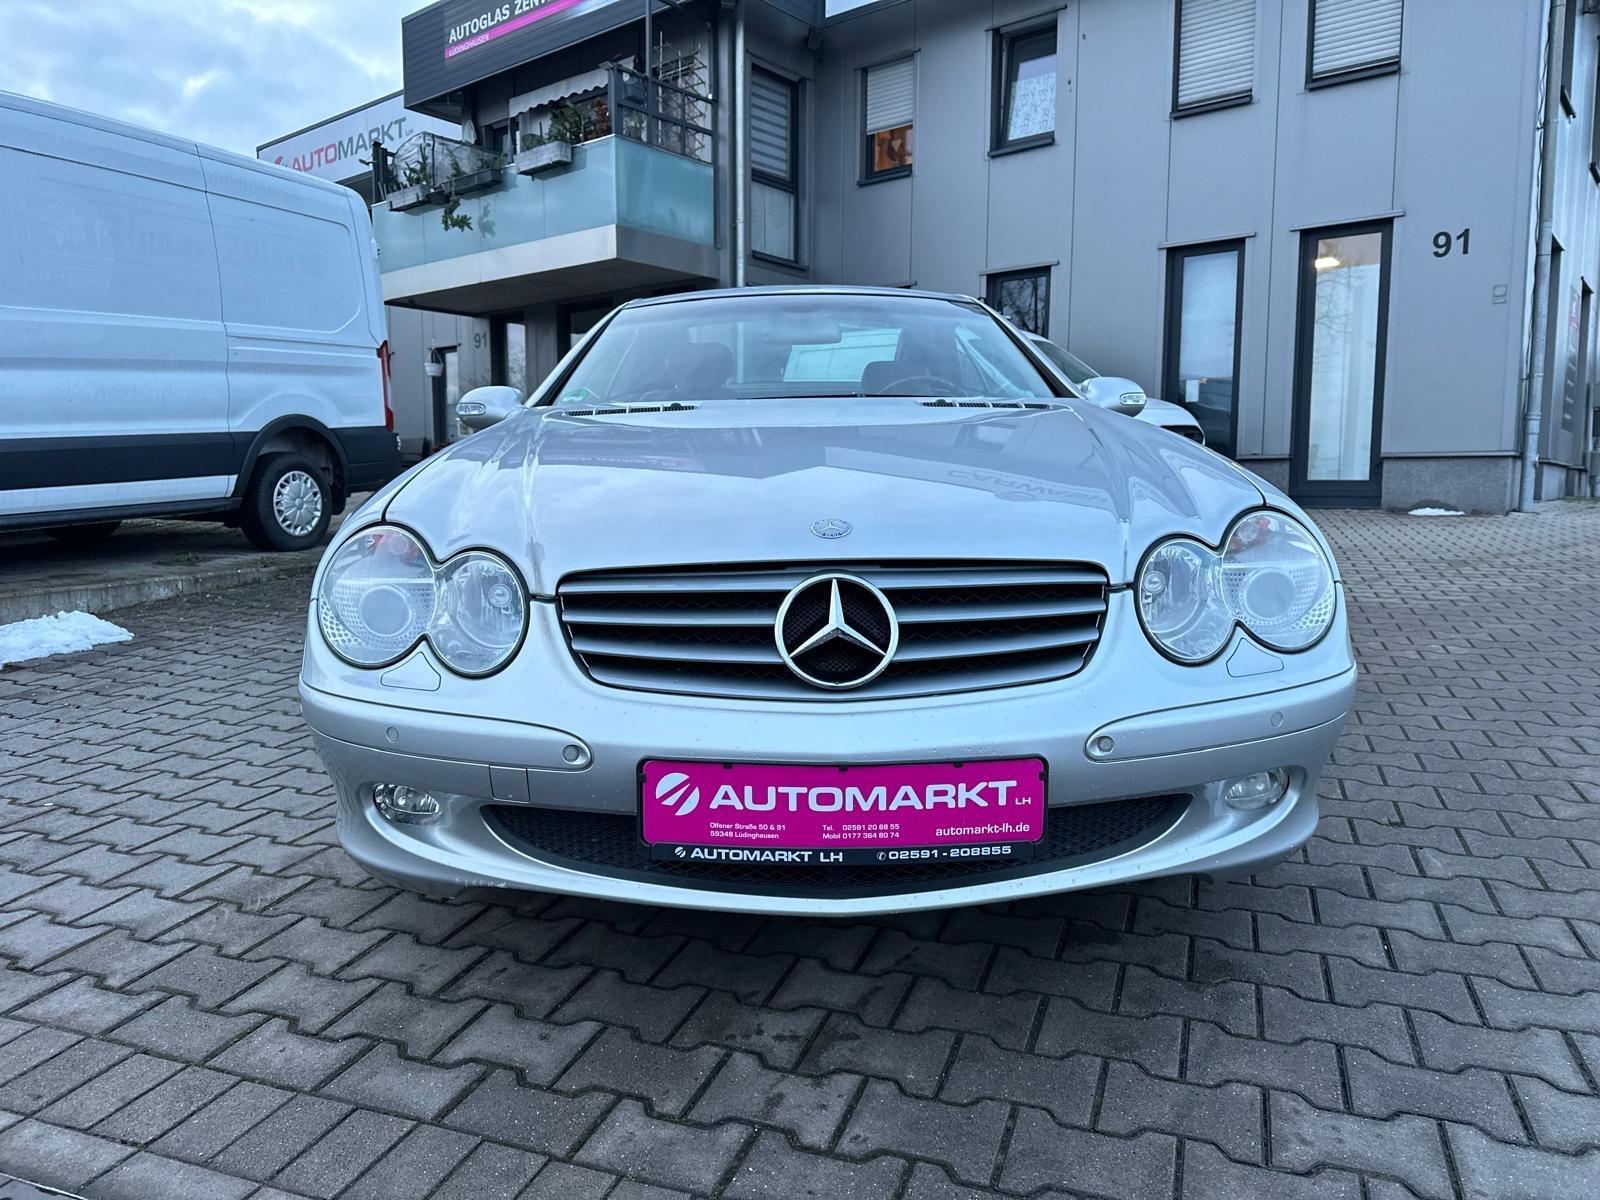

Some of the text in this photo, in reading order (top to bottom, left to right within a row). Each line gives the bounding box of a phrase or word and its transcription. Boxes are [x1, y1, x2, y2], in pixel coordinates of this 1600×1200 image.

[448, 4, 510, 44] AUTOGLAS
[291, 117, 406, 172] AUTOMARKT
[1433, 228, 1470, 258] 91
[474, 331, 487, 349] 91
[709, 780, 1032, 812] AUTOMARKT LH
[935, 822, 1030, 836] automarkt-lh.de
[690, 847, 843, 862] AUTOMARKT LH
[888, 849, 938, 859] 02591
[950, 845, 1011, 858] 208855
